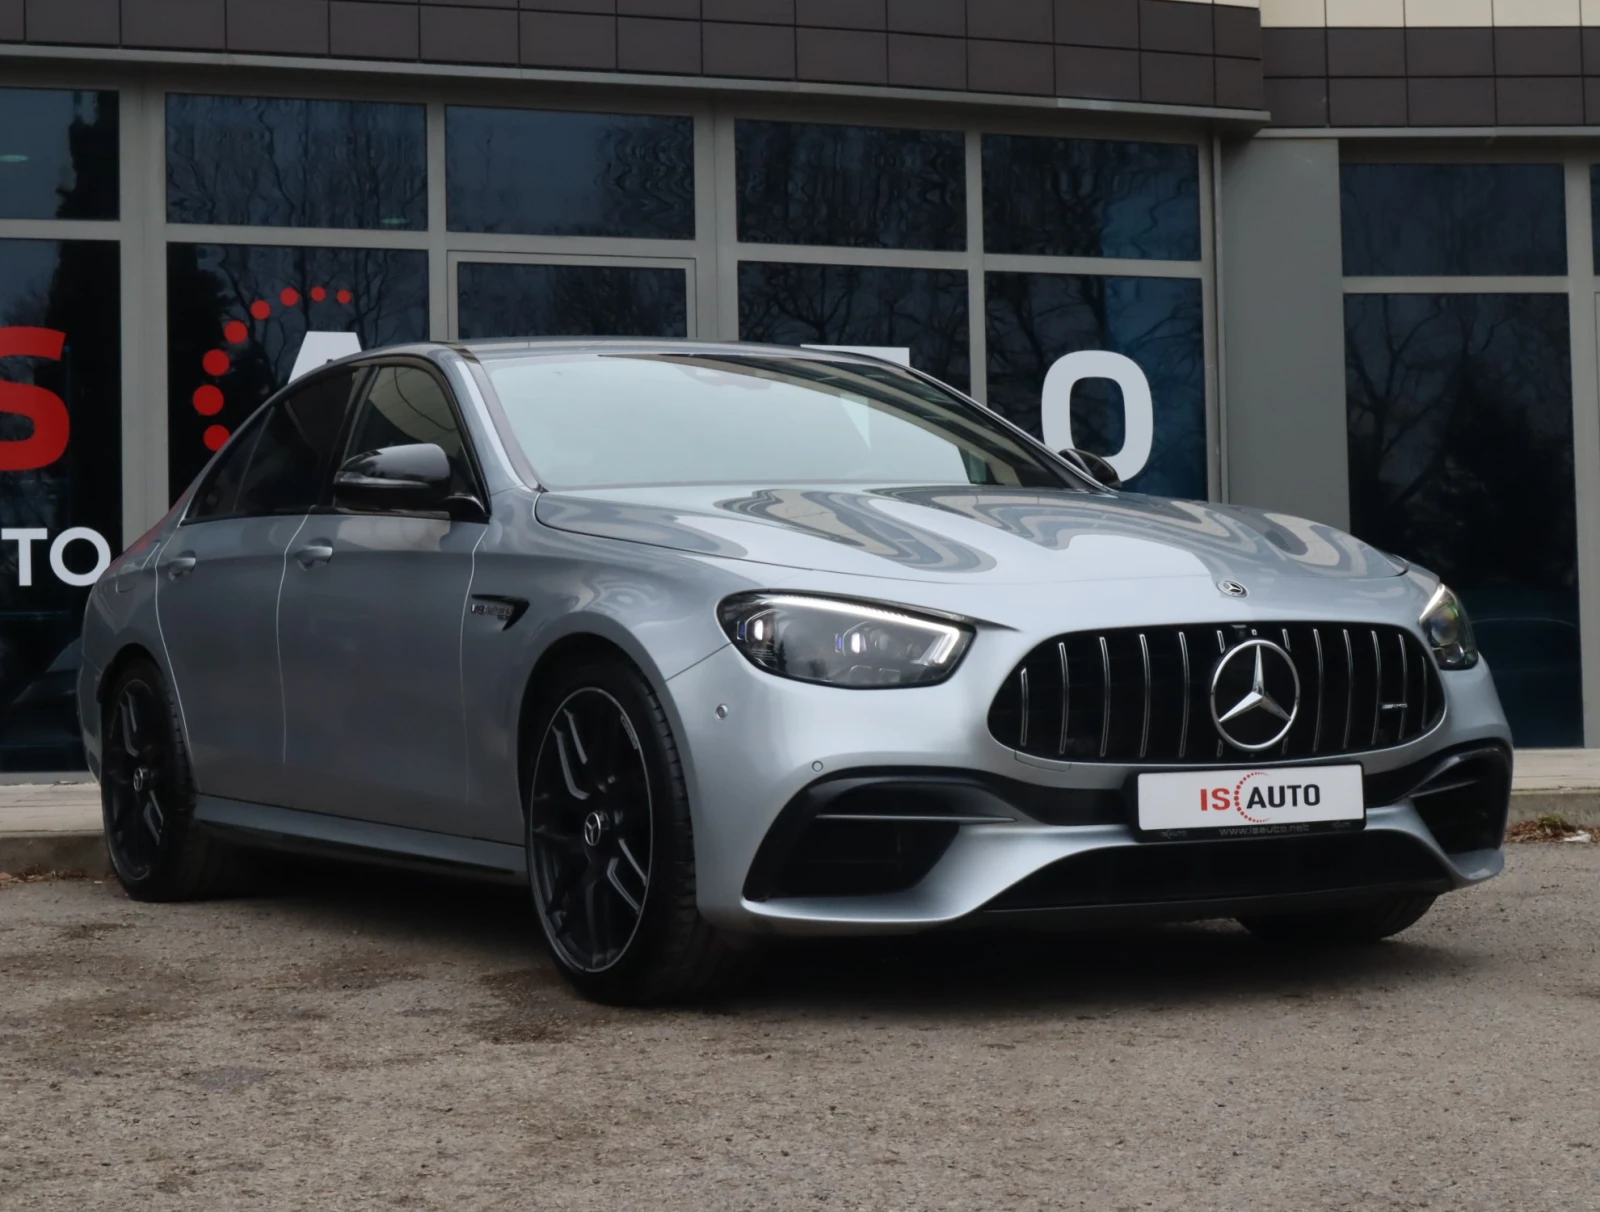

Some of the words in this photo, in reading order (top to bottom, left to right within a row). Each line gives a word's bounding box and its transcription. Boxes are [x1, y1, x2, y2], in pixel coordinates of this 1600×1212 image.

[1200, 788, 1230, 811] IS
[1246, 784, 1320, 809] AUTO
[1219, 823, 1310, 836] www.isauto.net
